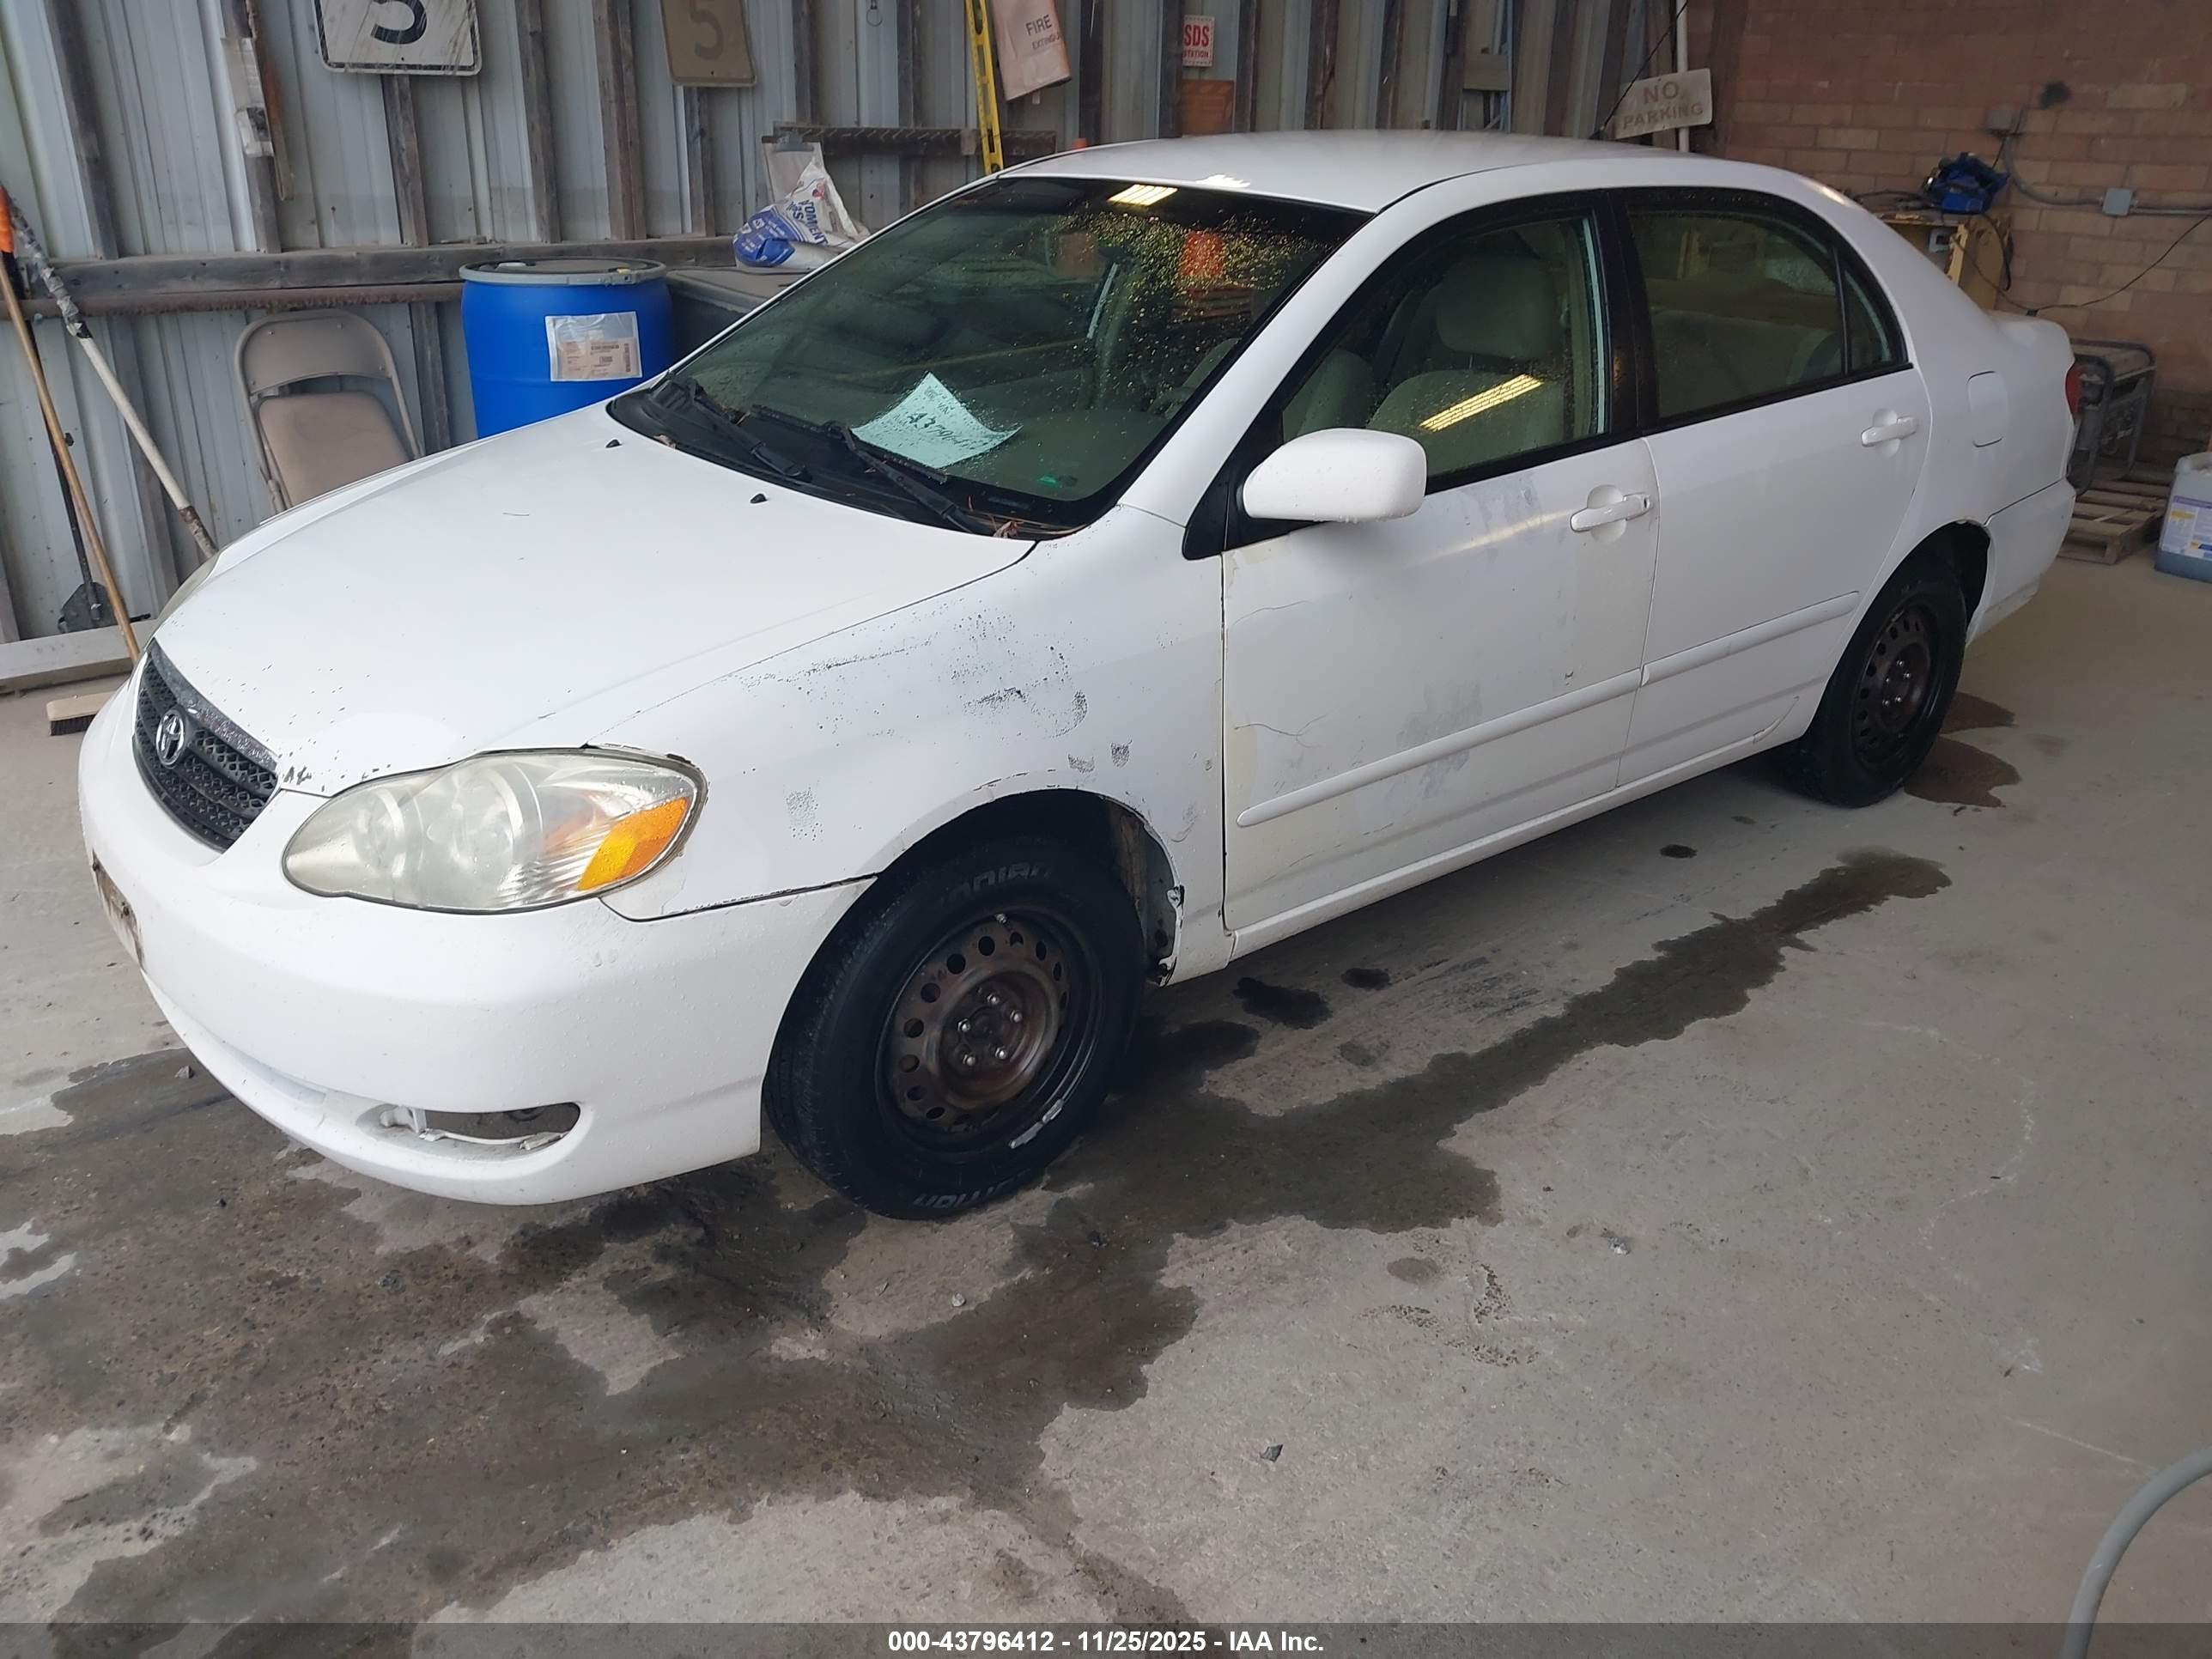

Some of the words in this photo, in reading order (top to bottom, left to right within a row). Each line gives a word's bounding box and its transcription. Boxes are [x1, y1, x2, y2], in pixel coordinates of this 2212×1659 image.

[1025, 14, 1052, 37] FIRE
[1184, 25, 1209, 46] SDS
[1643, 82, 1679, 105] NO
[1624, 103, 1704, 130] PARKING
